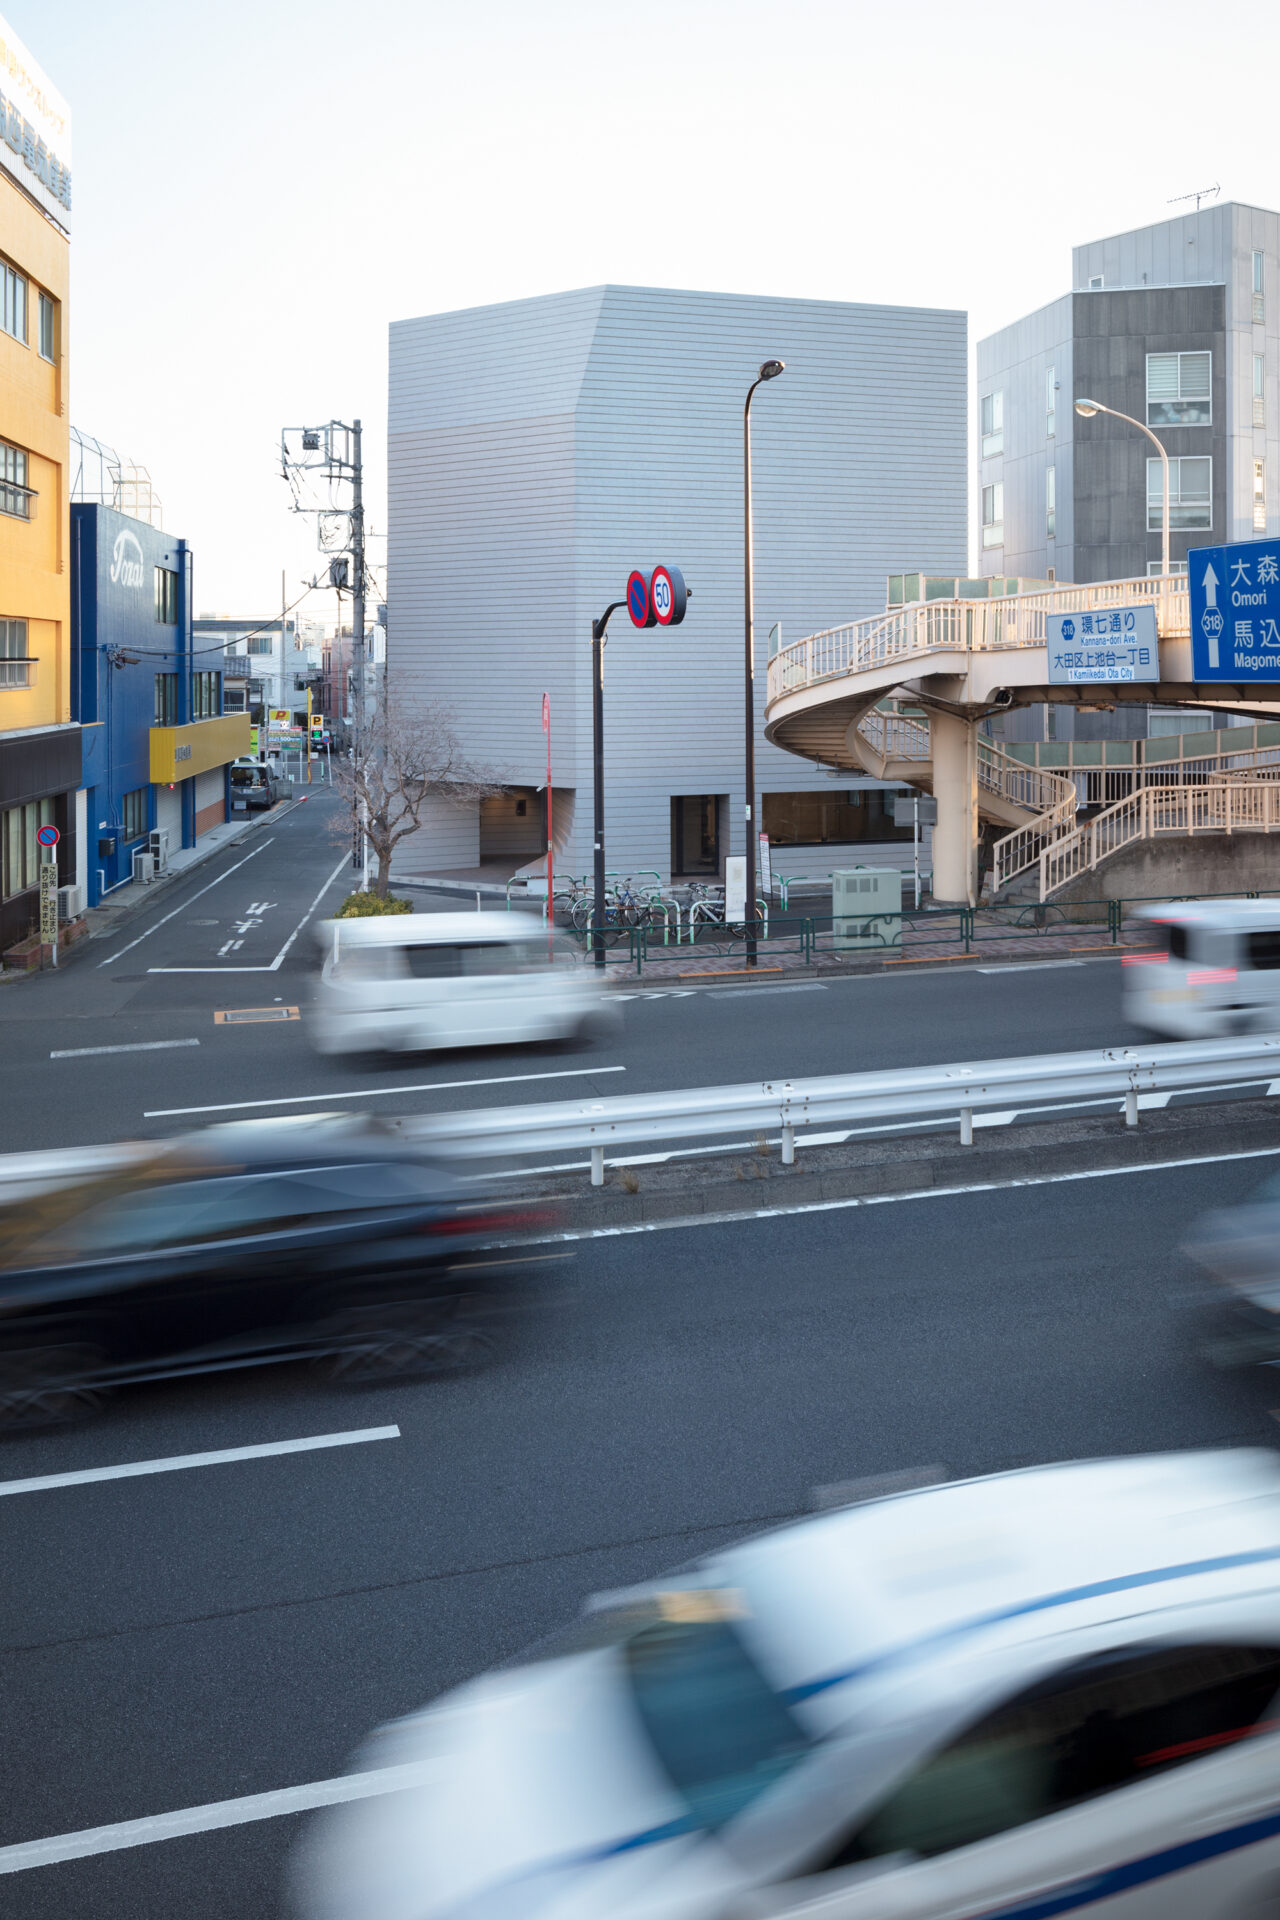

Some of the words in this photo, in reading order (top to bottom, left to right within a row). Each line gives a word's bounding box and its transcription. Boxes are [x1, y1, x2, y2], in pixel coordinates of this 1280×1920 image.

[1230, 555, 1280, 588] 大森
[655, 582, 670, 608] 50
[1231, 589, 1267, 607] Omori
[1063, 624, 1074, 638] 318
[1081, 612, 1136, 635] 環七通り
[1204, 614, 1221, 631] 318
[1080, 634, 1121, 647] Kannana-dori
[1123, 633, 1137, 645] Ave.
[1234, 619, 1280, 649] 馬込
[1054, 648, 1150, 669] 大田区上池台一丁目
[1107, 667, 1119, 679] Ota
[1120, 667, 1133, 681] City
[313, 716, 322, 726] P
[49, 866, 57, 887] この先
[41, 866, 49, 934] 通り抜けできません
[49, 900, 57, 934] 行き止まり
